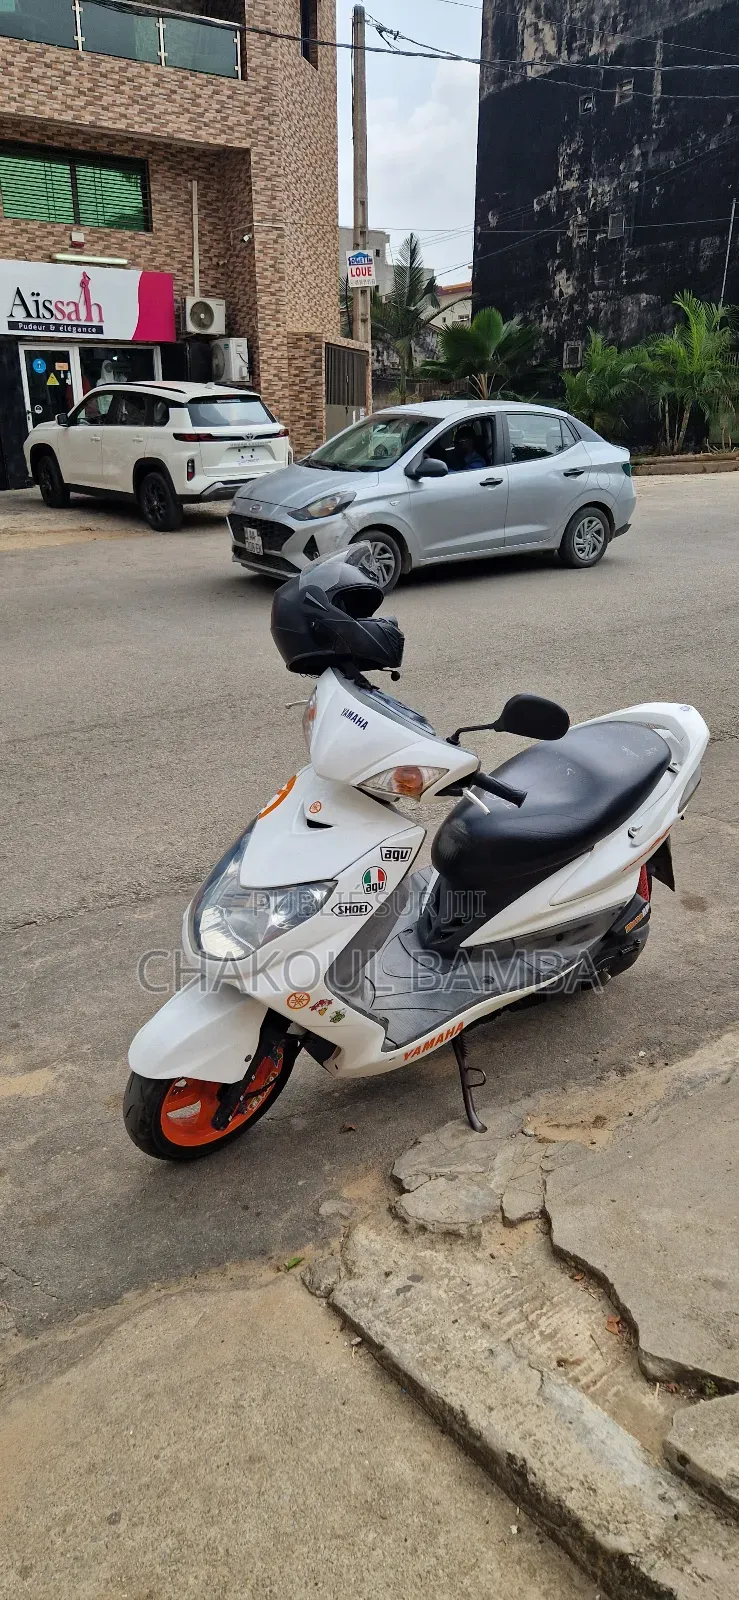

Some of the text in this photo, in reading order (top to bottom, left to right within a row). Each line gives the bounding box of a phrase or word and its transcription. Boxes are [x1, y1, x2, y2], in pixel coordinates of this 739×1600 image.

[350, 266, 372, 277] LOUE
[7, 271, 104, 322] Aïssah
[18, 322, 46, 331] Pudeur
[59, 325, 97, 333] élégance
[341, 708, 369, 730] YAMAHA
[384, 849, 408, 861] agv
[365, 881, 384, 893] agv
[338, 904, 368, 914] SHOEI
[404, 1021, 464, 1061] YAMAHA
